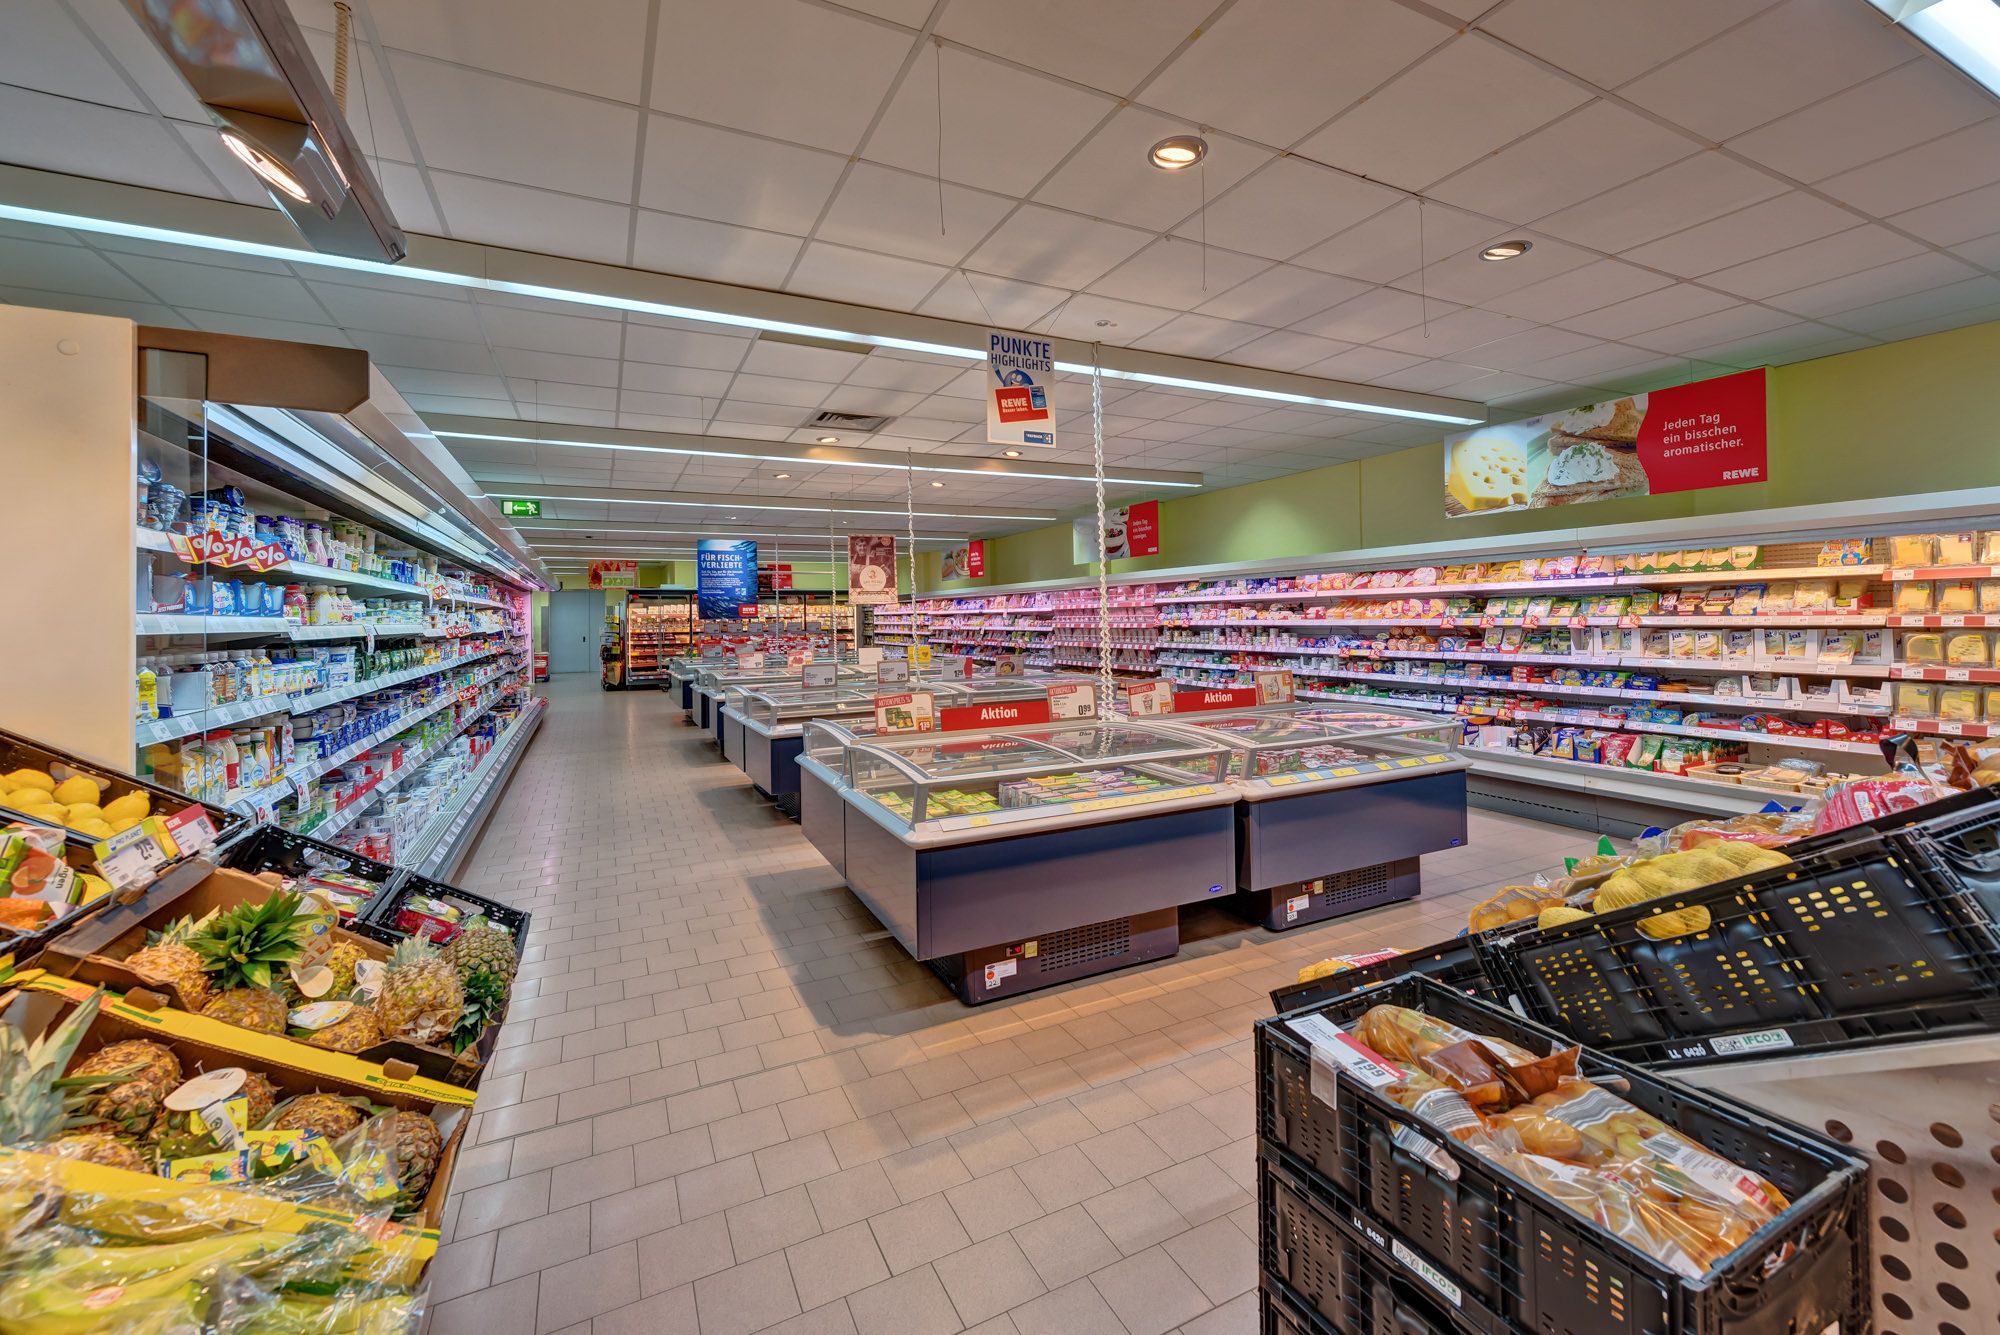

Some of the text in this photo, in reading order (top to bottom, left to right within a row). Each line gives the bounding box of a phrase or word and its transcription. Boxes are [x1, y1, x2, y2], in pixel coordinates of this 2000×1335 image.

[990, 334, 1051, 360] PUNKTE
[990, 353, 1051, 372] HIGHLIGHTS
[1000, 398, 1028, 408] REWE
[1662, 411, 1720, 432] Jeden Tag
[1663, 422, 1737, 444] ein bisschen
[1663, 436, 1744, 458] aromatischer.
[1722, 467, 1760, 480] REWE
[1789, 632, 1801, 640] ja!
[1866, 632, 1879, 641] ja!
[878, 696, 905, 706] AKTIONSPREIS
[1204, 692, 1233, 704] Aktion
[980, 706, 1018, 720] Aktion
[1078, 704, 1091, 715] 0.99
[116, 828, 142, 845] PRO PLANET
[134, 837, 154, 860] 2.79
[1742, 1033, 1771, 1045] IFCO
[1352, 1057, 1385, 1077] 1.99
[1380, 1063, 1400, 1076] REWE
[1366, 1227, 1385, 1247] 6420
[1422, 1263, 1447, 1288] IFCO
